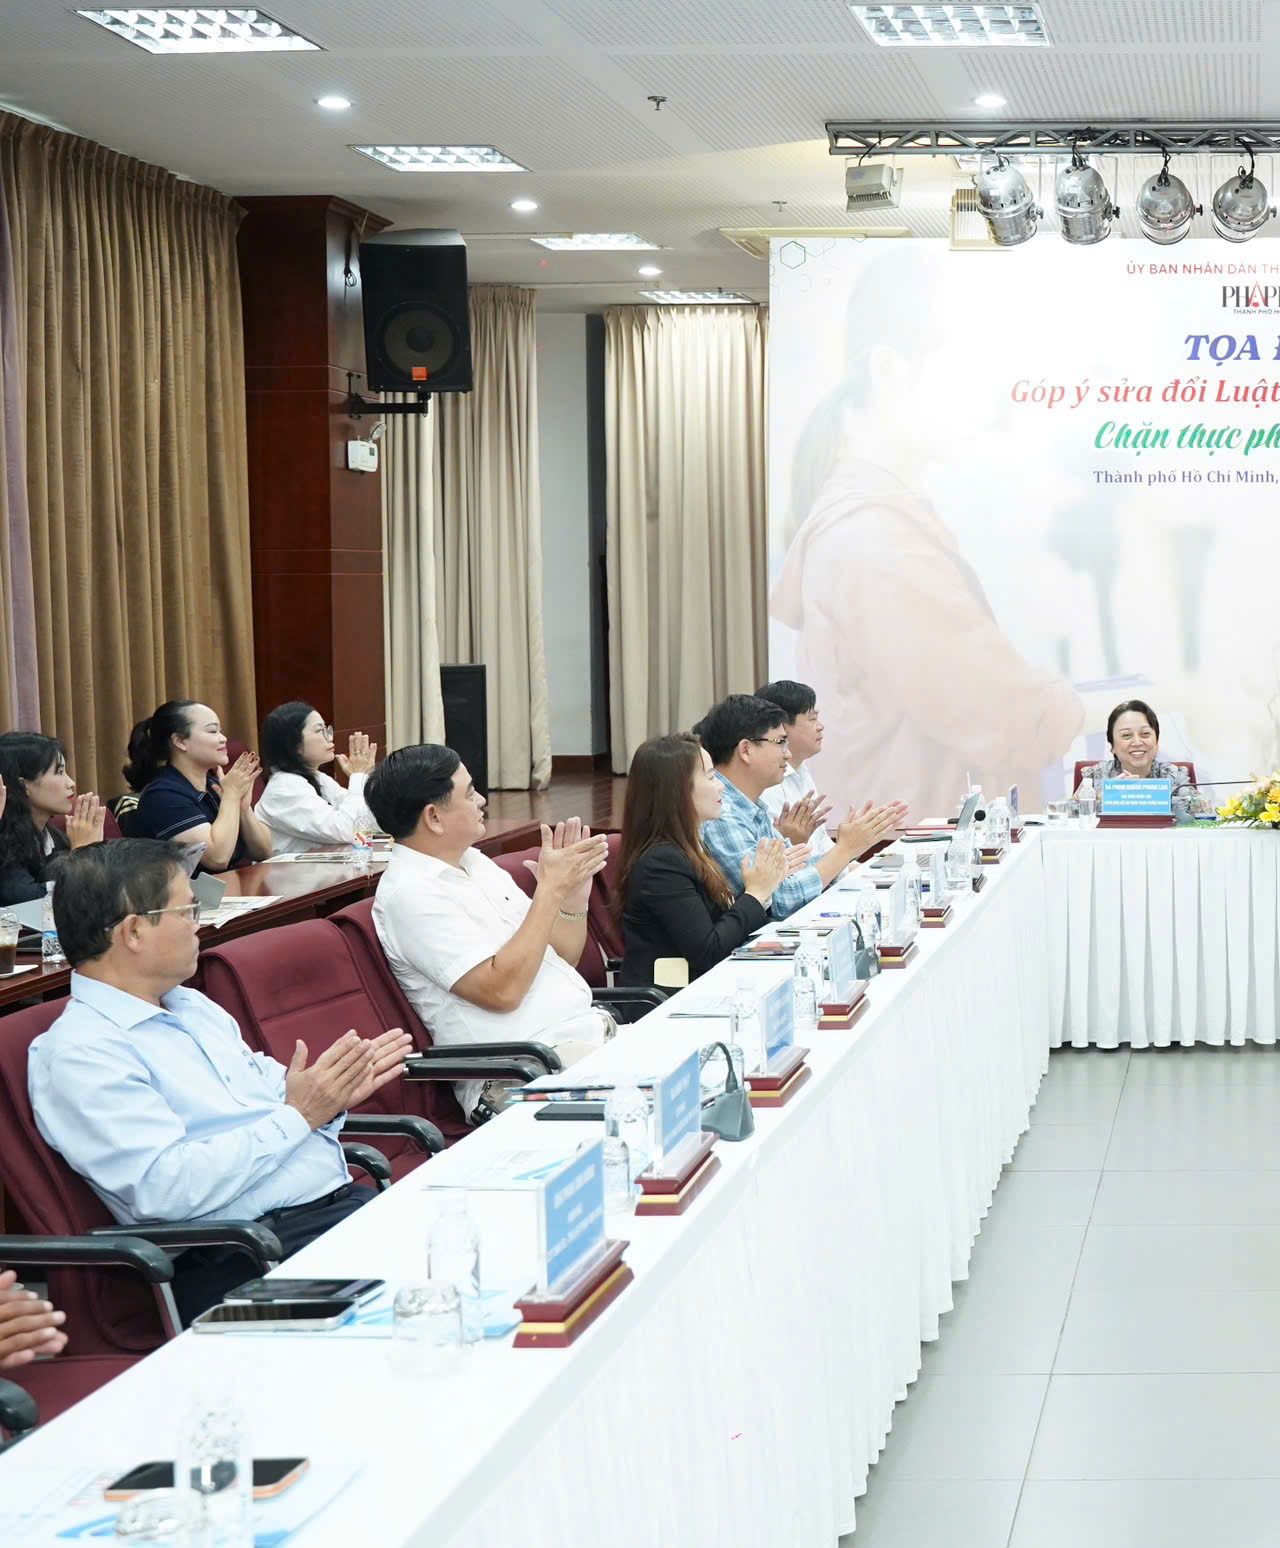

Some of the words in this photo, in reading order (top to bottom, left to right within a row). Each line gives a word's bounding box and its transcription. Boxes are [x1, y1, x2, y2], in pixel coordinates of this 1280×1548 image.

[1149, 263, 1178, 275] BAN
[1182, 260, 1223, 275] NHÂN
[1184, 334, 1261, 366] TỌA
[1011, 378, 1065, 409] Góp
[1070, 378, 1090, 409] ý
[1097, 377, 1152, 402] sửa
[1161, 376, 1207, 402] đổi
[1095, 420, 1171, 456] Chặn
[1176, 422, 1242, 456] thực
[1093, 470, 1143, 483] Thành
[1148, 469, 1177, 487] phố
[1182, 468, 1203, 483] Hồ
[1207, 470, 1232, 483] Chí
[1236, 470, 1279, 485] Minh,
